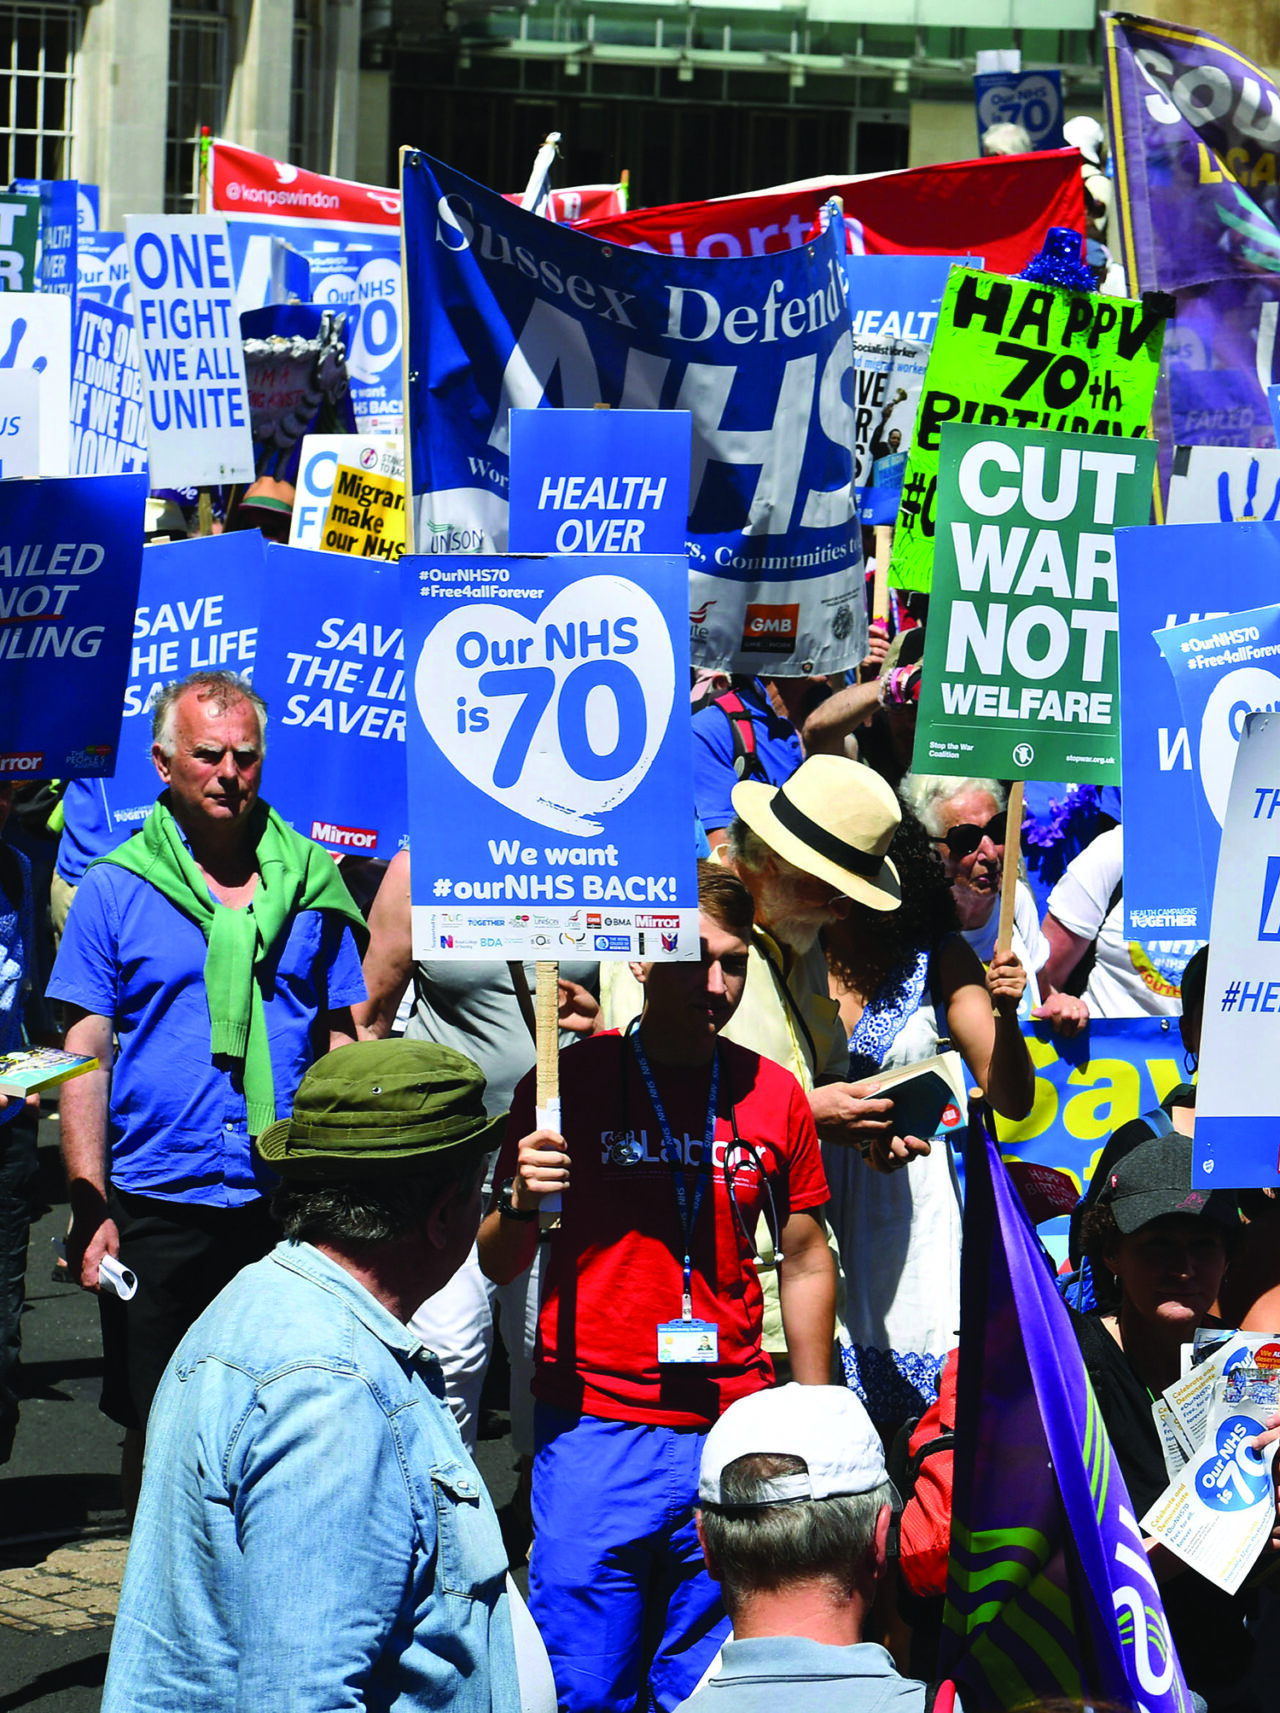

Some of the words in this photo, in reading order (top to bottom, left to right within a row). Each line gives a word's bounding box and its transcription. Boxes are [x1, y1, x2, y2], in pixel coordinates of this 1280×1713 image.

[226, 181, 340, 209] @konpswindon
[134, 232, 230, 290] ONE
[436, 193, 638, 330] Sussex
[358, 279, 396, 300] NHS
[140, 298, 231, 340] FIGHT
[145, 348, 188, 381] WE
[196, 347, 240, 380] ALL
[995, 341, 1122, 411] 70th
[149, 387, 246, 431] UNITE
[538, 477, 666, 510] HEALTH
[958, 440, 1136, 525] CUT
[331, 504, 384, 534] make
[555, 519, 645, 552] OVER
[326, 530, 358, 553] our
[714, 542, 847, 571] Communities
[419, 569, 510, 582] #OurNHS70
[950, 522, 1119, 602] WAR
[420, 585, 544, 600] #Free4allForever
[133, 595, 224, 639] SAVE
[750, 618, 792, 632] GMB
[131, 645, 178, 677] HE
[190, 628, 258, 671] LIFE
[456, 631, 534, 668] Our
[545, 616, 639, 662] NHS
[945, 600, 1119, 683] NOT
[1180, 626, 1260, 654] #OurNHS70
[286, 652, 363, 695] THE
[941, 682, 1113, 725] WELFARE
[457, 696, 489, 734] is
[478, 659, 648, 789] 70
[929, 741, 946, 751] Stop
[947, 743, 959, 751] the
[960, 743, 974, 752] War
[929, 750, 960, 759] Coalition
[1066, 755, 1116, 765] stopwar.org.uk
[311, 822, 376, 849] Mirror
[488, 840, 538, 866] We
[544, 844, 618, 867] want
[432, 874, 575, 900] #ourNHS
[583, 876, 677, 902] BACK!
[635, 915, 680, 928] Mirror
[1129, 914, 1197, 928] TOGETHER
[480, 938, 503, 947] BDA
[1173, 1375, 1203, 1399] Celebrate
[1203, 1364, 1216, 1377] and
[1176, 1373, 1216, 1405] Demonstrate
[1202, 1462, 1226, 1489] Our
[1222, 1422, 1248, 1462] NHS
[1150, 1497, 1176, 1528] Celebrate
[1175, 1483, 1187, 1498] and
[1217, 1488, 1233, 1505] is
[1164, 1503, 1190, 1537] #OurNHS70
